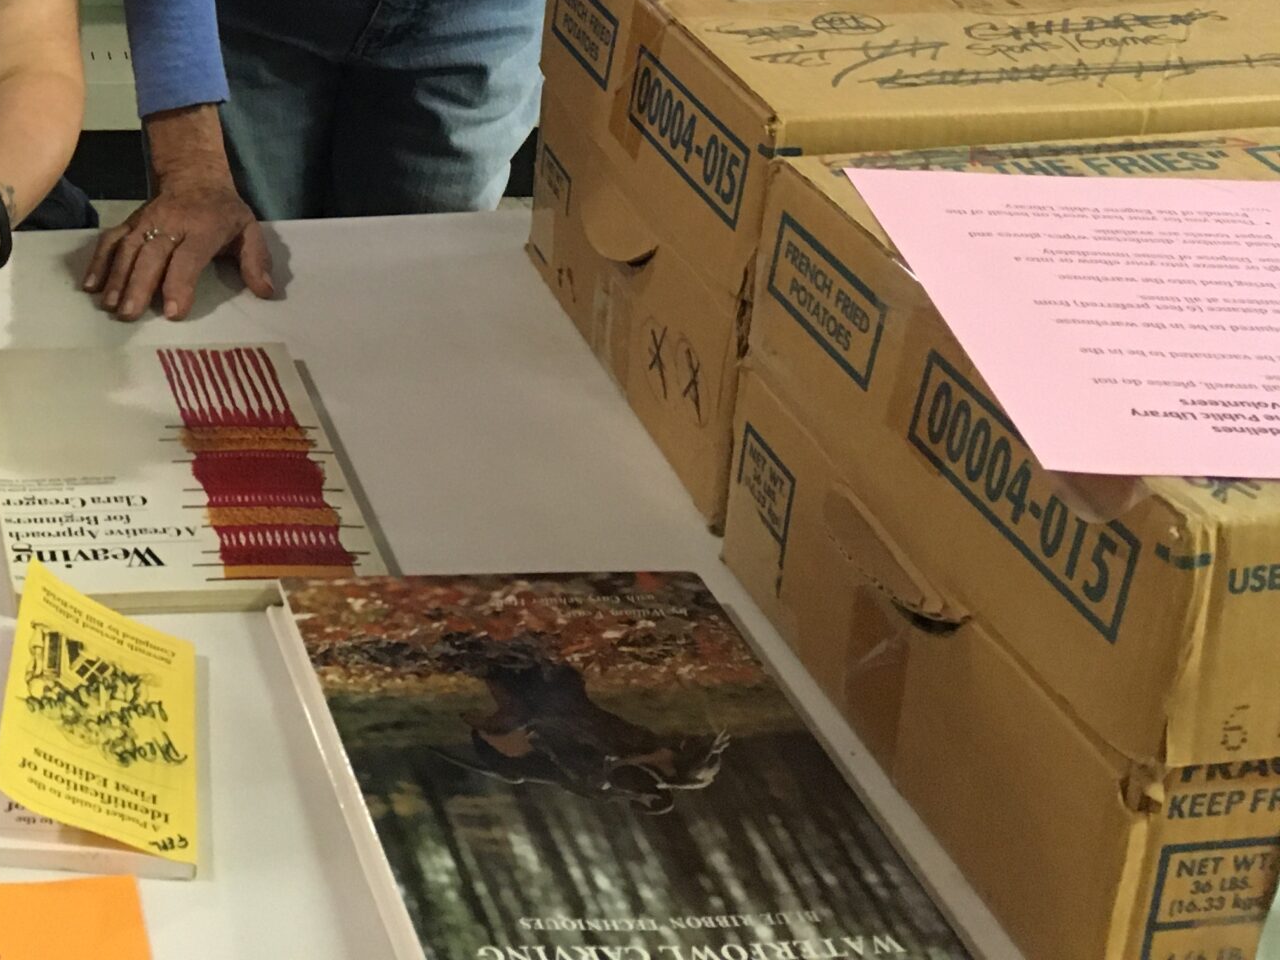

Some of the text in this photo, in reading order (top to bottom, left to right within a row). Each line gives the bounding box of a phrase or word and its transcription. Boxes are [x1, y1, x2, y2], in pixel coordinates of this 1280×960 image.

[563, 13, 601, 61] POTATOES
[589, 12, 612, 47] FRIED
[636, 65, 741, 206] 00004-015
[785, 242, 871, 335] FRENCH FRIED
[789, 278, 853, 352] POTATOES
[1079, 346, 1105, 356] the
[1128, 349, 1145, 358] be
[1146, 350, 1165, 359] to
[1170, 350, 1252, 361] vaccinated
[1092, 377, 1119, 386] not
[1122, 377, 1142, 387] do
[1147, 379, 1197, 389] please
[1130, 407, 1261, 423] Public Library
[1, 495, 148, 508] Clara Creager
[925, 380, 1120, 604] 00004-015
[4, 513, 131, 526] for Beginners
[8, 525, 198, 541] A Creative Approach
[11, 543, 166, 568] Weaving
[42, 596, 81, 624] Edition
[84, 613, 105, 626] Bill
[80, 620, 125, 645] Revised
[121, 632, 177, 658] Compiled
[26, 776, 51, 793] the
[33, 747, 159, 806] First Editions
[18, 756, 171, 825] Identification of
[58, 789, 70, 800] to
[70, 792, 105, 814] Guide
[1167, 791, 1245, 820] KEEP
[107, 807, 149, 830] Pocket
[1176, 856, 1220, 878] NET
[1190, 880, 1211, 895] 36
[518, 910, 821, 933] BLUE RIBBON TECHNIQUES
[477, 944, 650, 960] CARVING
[659, 934, 906, 960] WATERFOWL
